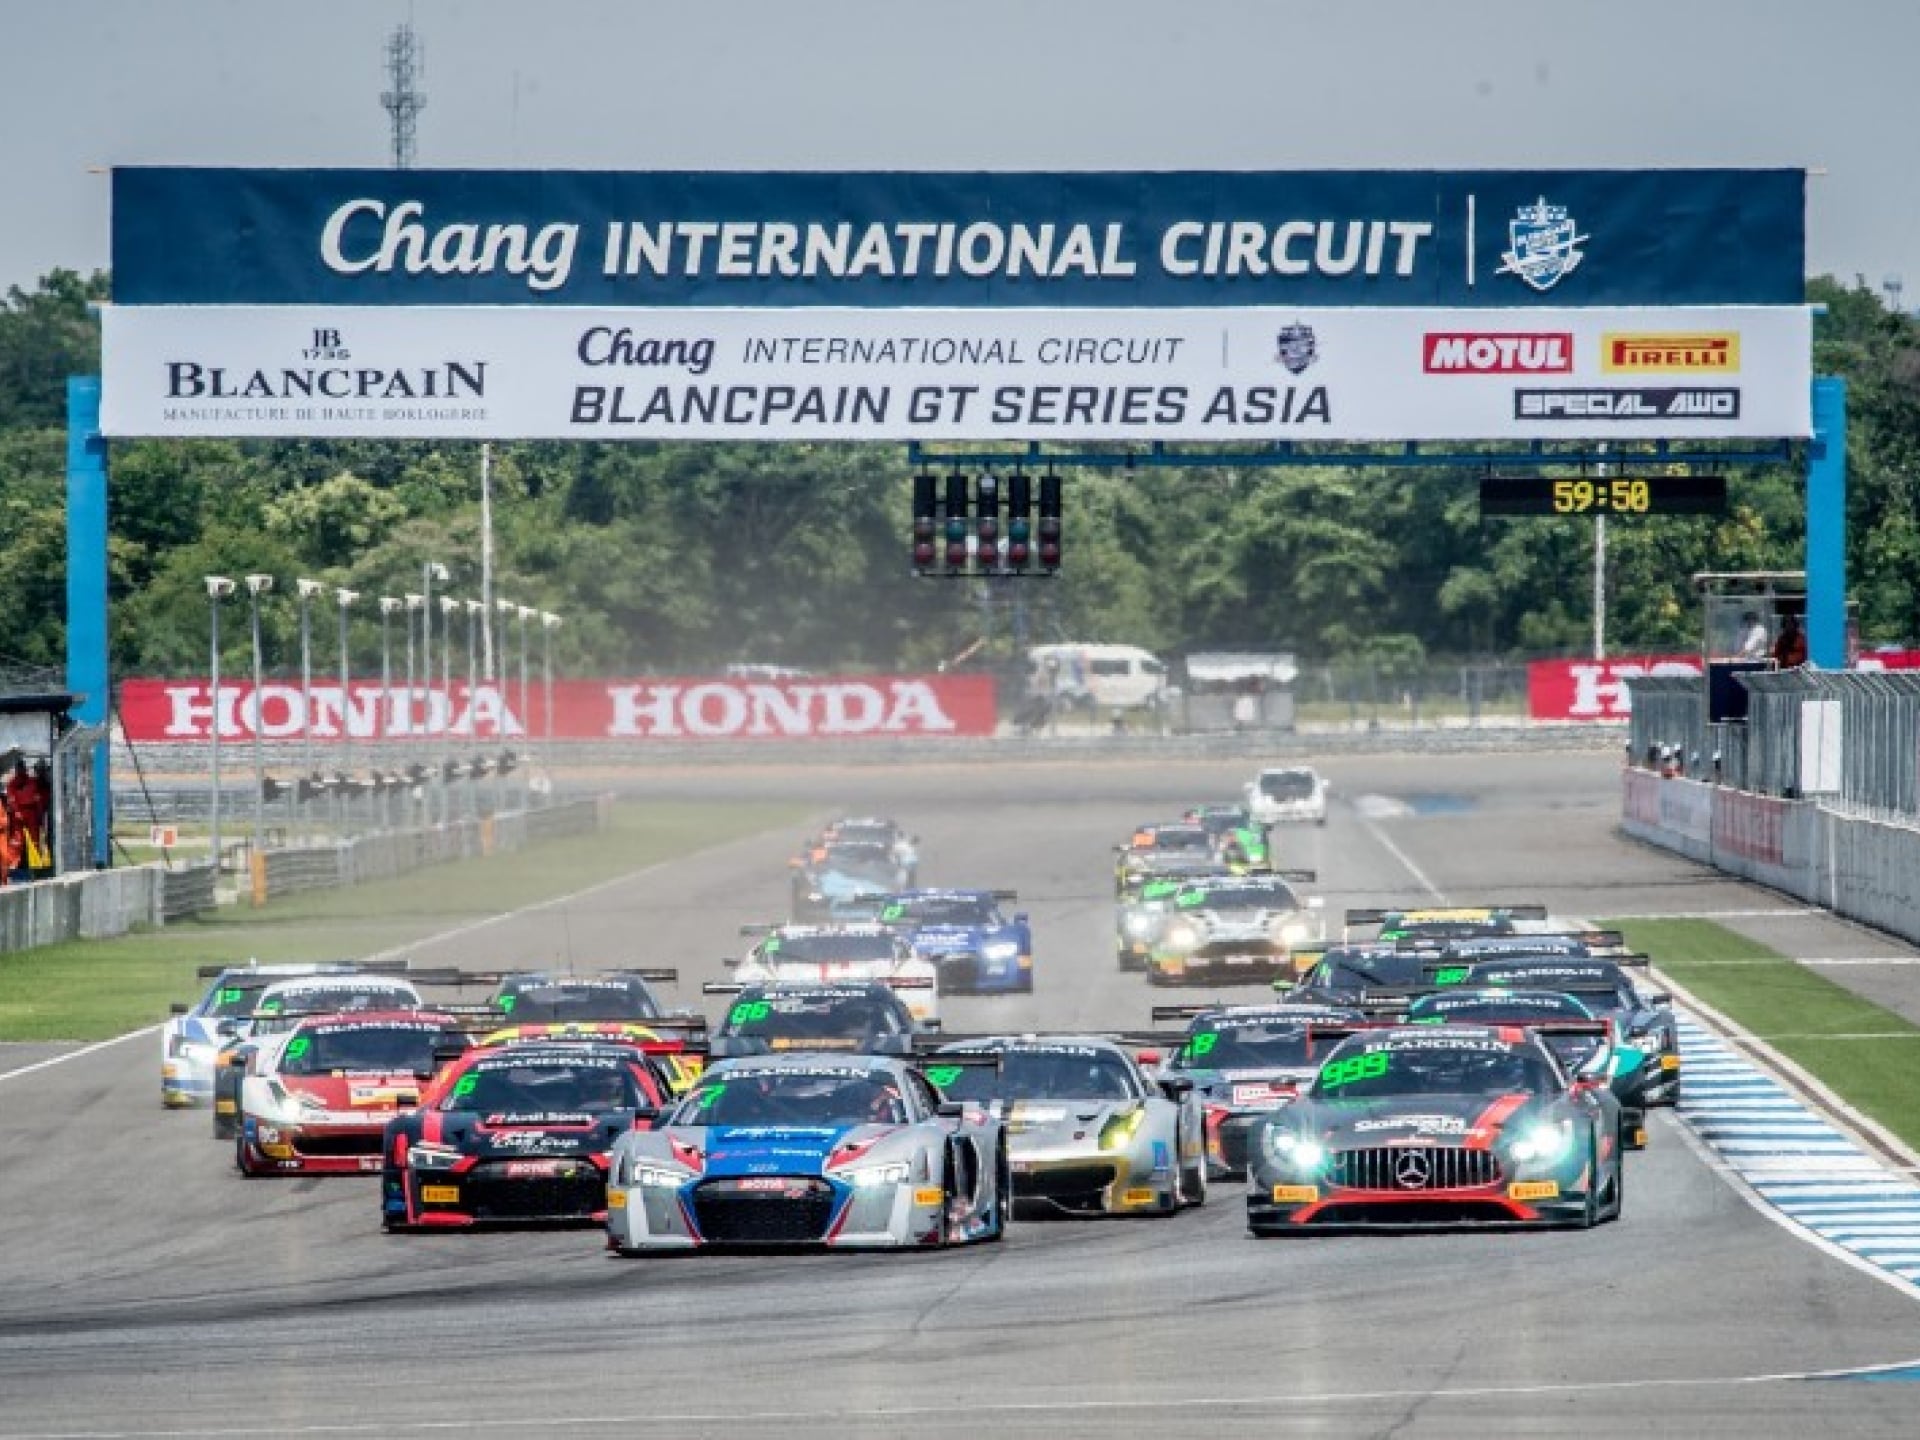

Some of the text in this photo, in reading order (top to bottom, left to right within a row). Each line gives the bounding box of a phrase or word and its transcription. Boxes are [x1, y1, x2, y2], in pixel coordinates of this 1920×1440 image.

[320, 198, 1432, 290] Chang INTERNATIONAL CIRCUIT
[577, 326, 1184, 375] Chang INTERNATIONAL CIRCUIT
[1430, 337, 1567, 369] MOTUL
[1611, 338, 1729, 366] PIRELLI
[164, 361, 488, 399] BLANCPAIN
[570, 386, 1333, 425] BLANCPAIN GT SERIES ASIA
[1519, 392, 1657, 415] SPECIAL
[1553, 480, 1649, 512] 59:50
[163, 685, 525, 737] HONDA
[606, 680, 957, 736] HONDA
[1321, 1052, 1390, 1090] 999
